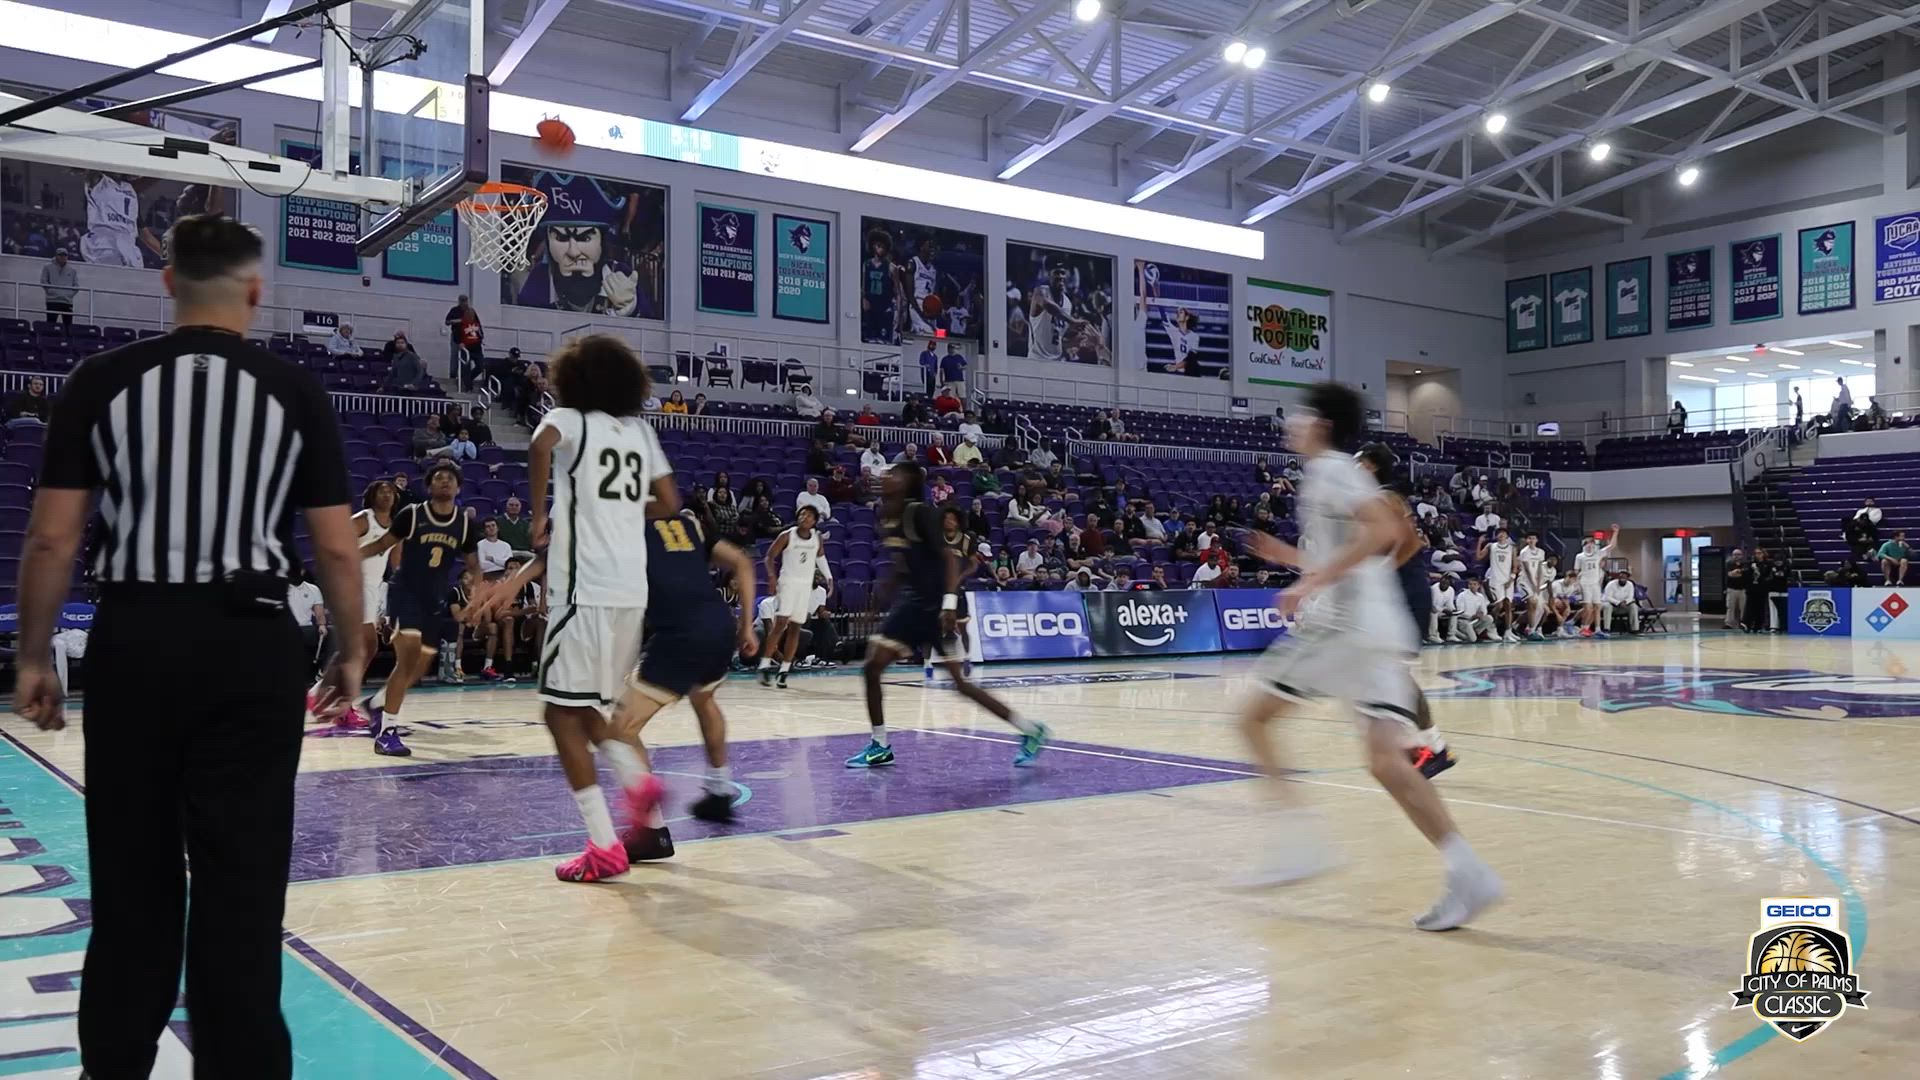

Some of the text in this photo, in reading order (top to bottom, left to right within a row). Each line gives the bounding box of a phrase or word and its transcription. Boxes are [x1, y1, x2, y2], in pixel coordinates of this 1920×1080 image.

[551, 186, 583, 215] FSW
[288, 204, 356, 221] CHAMPIONS
[288, 215, 357, 233] 2018 2019 2020
[288, 227, 357, 245] 2021 2022 2025
[423, 233, 453, 246] 2020
[702, 255, 752, 271] CHAMPIONS
[779, 285, 801, 296] 2020
[1878, 277, 1896, 287] 3RD
[1734, 287, 1755, 296] 2017
[1883, 283, 1920, 300] 2017
[316, 314, 333, 325] 116
[1246, 305, 1328, 333] CROWTHER
[1252, 326, 1320, 351] ROOFING
[598, 447, 642, 502] 23
[420, 532, 457, 550] WHEELER
[1116, 599, 1189, 627] alexa+
[982, 611, 1083, 638] GEICO
